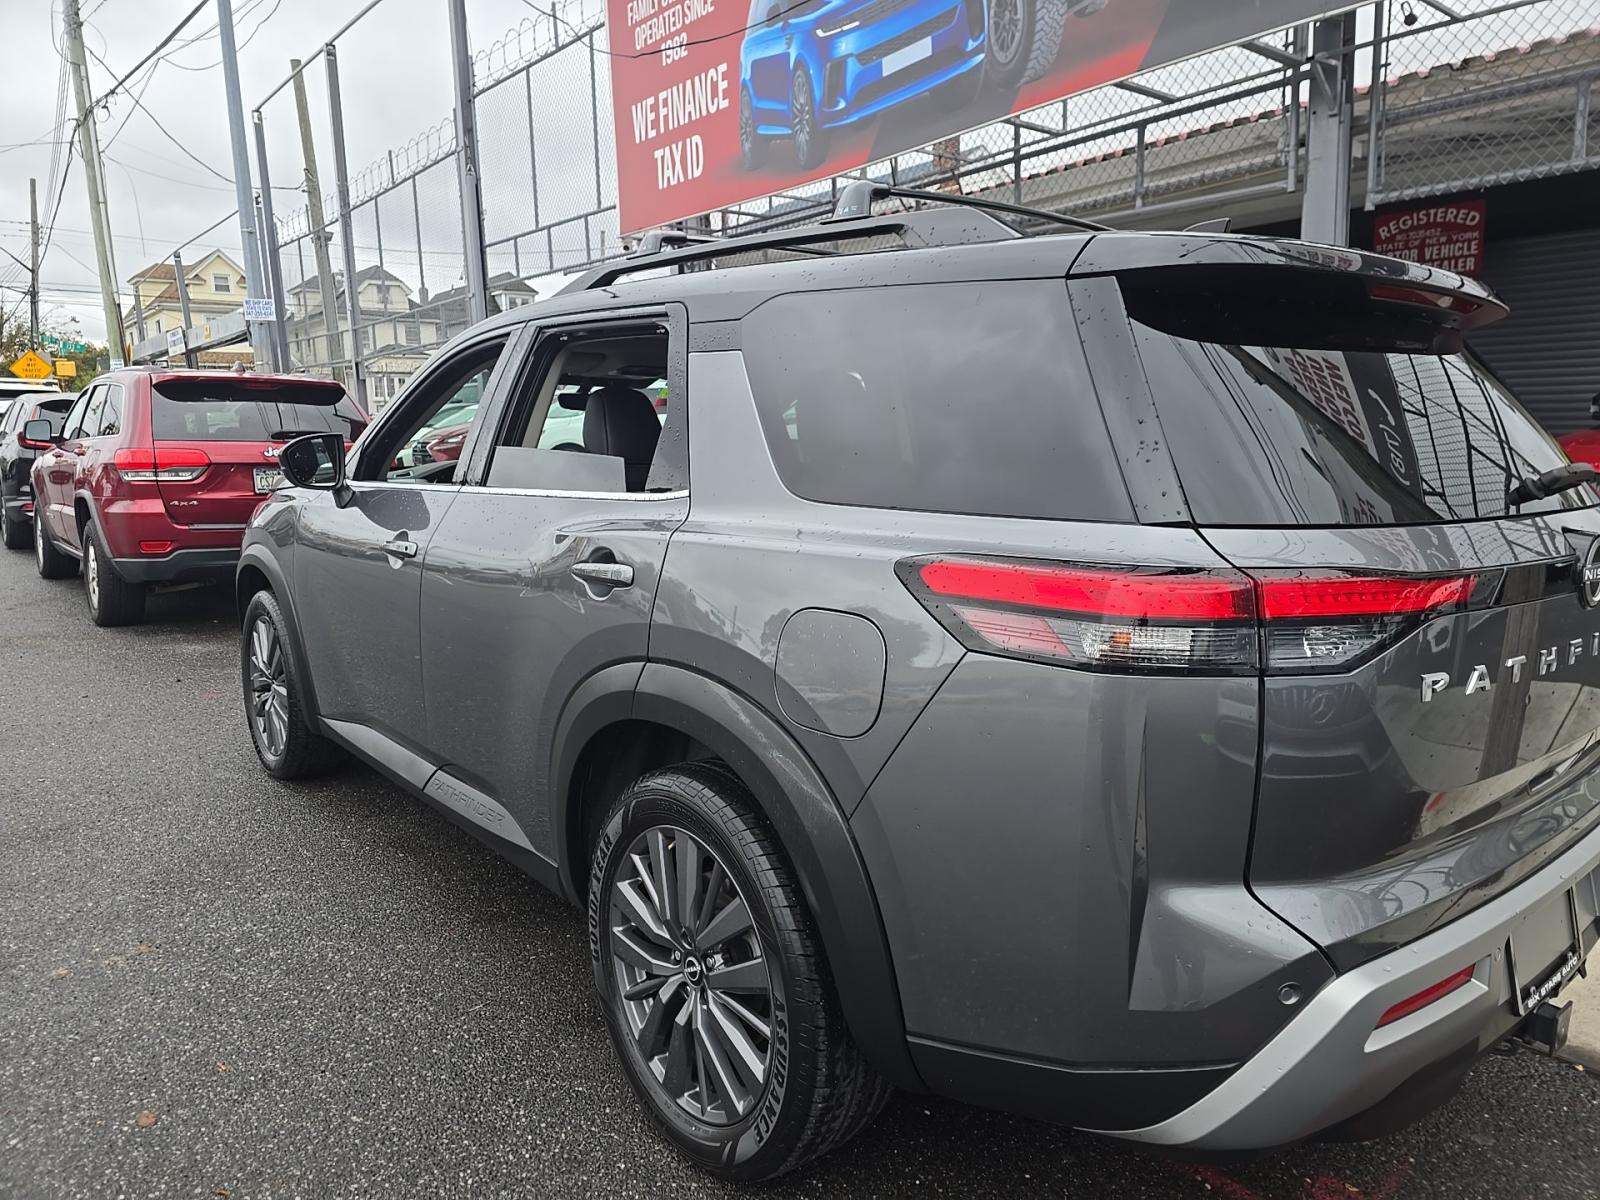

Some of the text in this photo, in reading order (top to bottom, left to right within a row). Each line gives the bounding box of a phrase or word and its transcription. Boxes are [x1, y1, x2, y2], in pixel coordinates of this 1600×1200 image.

[634, 0, 716, 51] OPERATED SINCE
[661, 31, 688, 66] 1982
[631, 62, 730, 144] WE FINANCE
[654, 134, 704, 190] TAX ID
[1376, 231, 1480, 252] STATE OF NEW YORK
[1378, 207, 1480, 241] REGISTERED
[1425, 240, 1479, 260] VEHICLE
[1562, 956, 1578, 976] AUTO
[752, 992, 789, 1146] ASSURANCE
